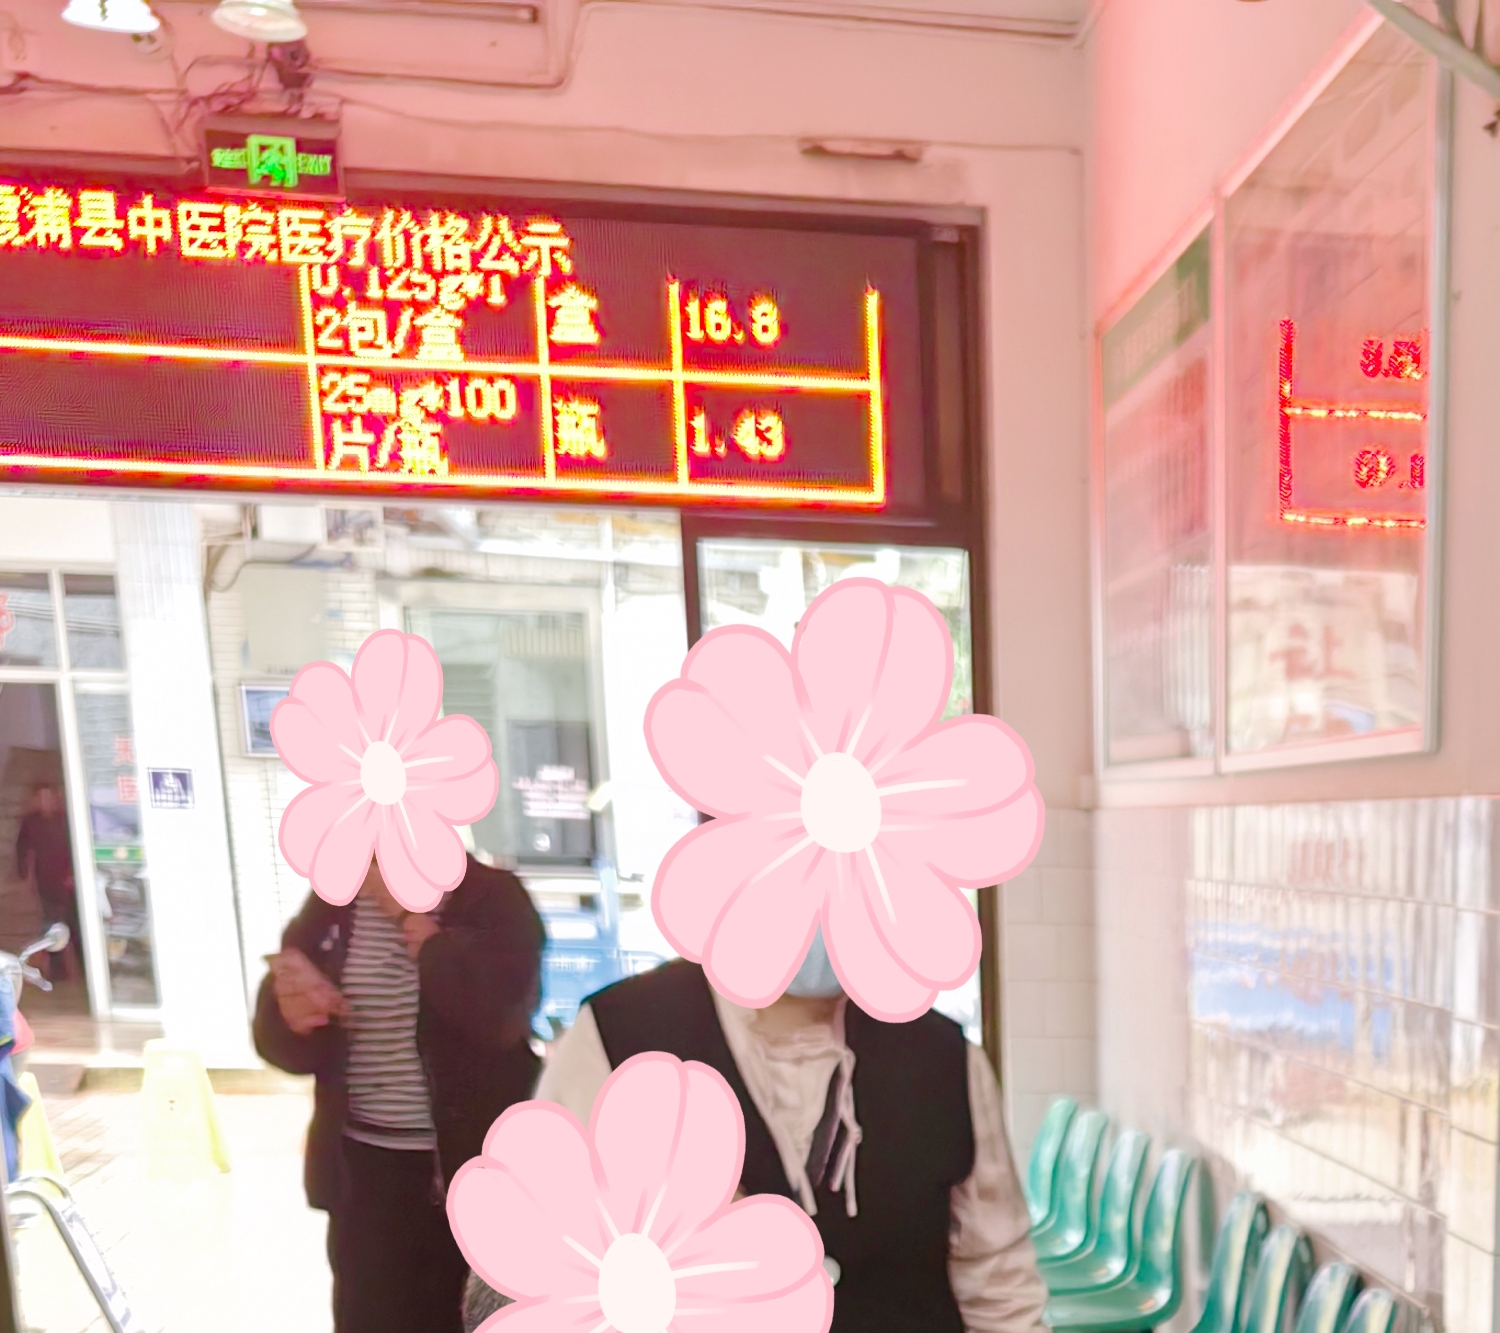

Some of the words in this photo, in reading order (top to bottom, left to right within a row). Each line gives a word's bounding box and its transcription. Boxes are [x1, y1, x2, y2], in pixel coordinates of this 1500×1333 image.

[315, 302, 465, 361] 2包/盒
[547, 285, 601, 344] 盒
[685, 297, 781, 343] 16.8
[689, 411, 786, 458] 1.43
